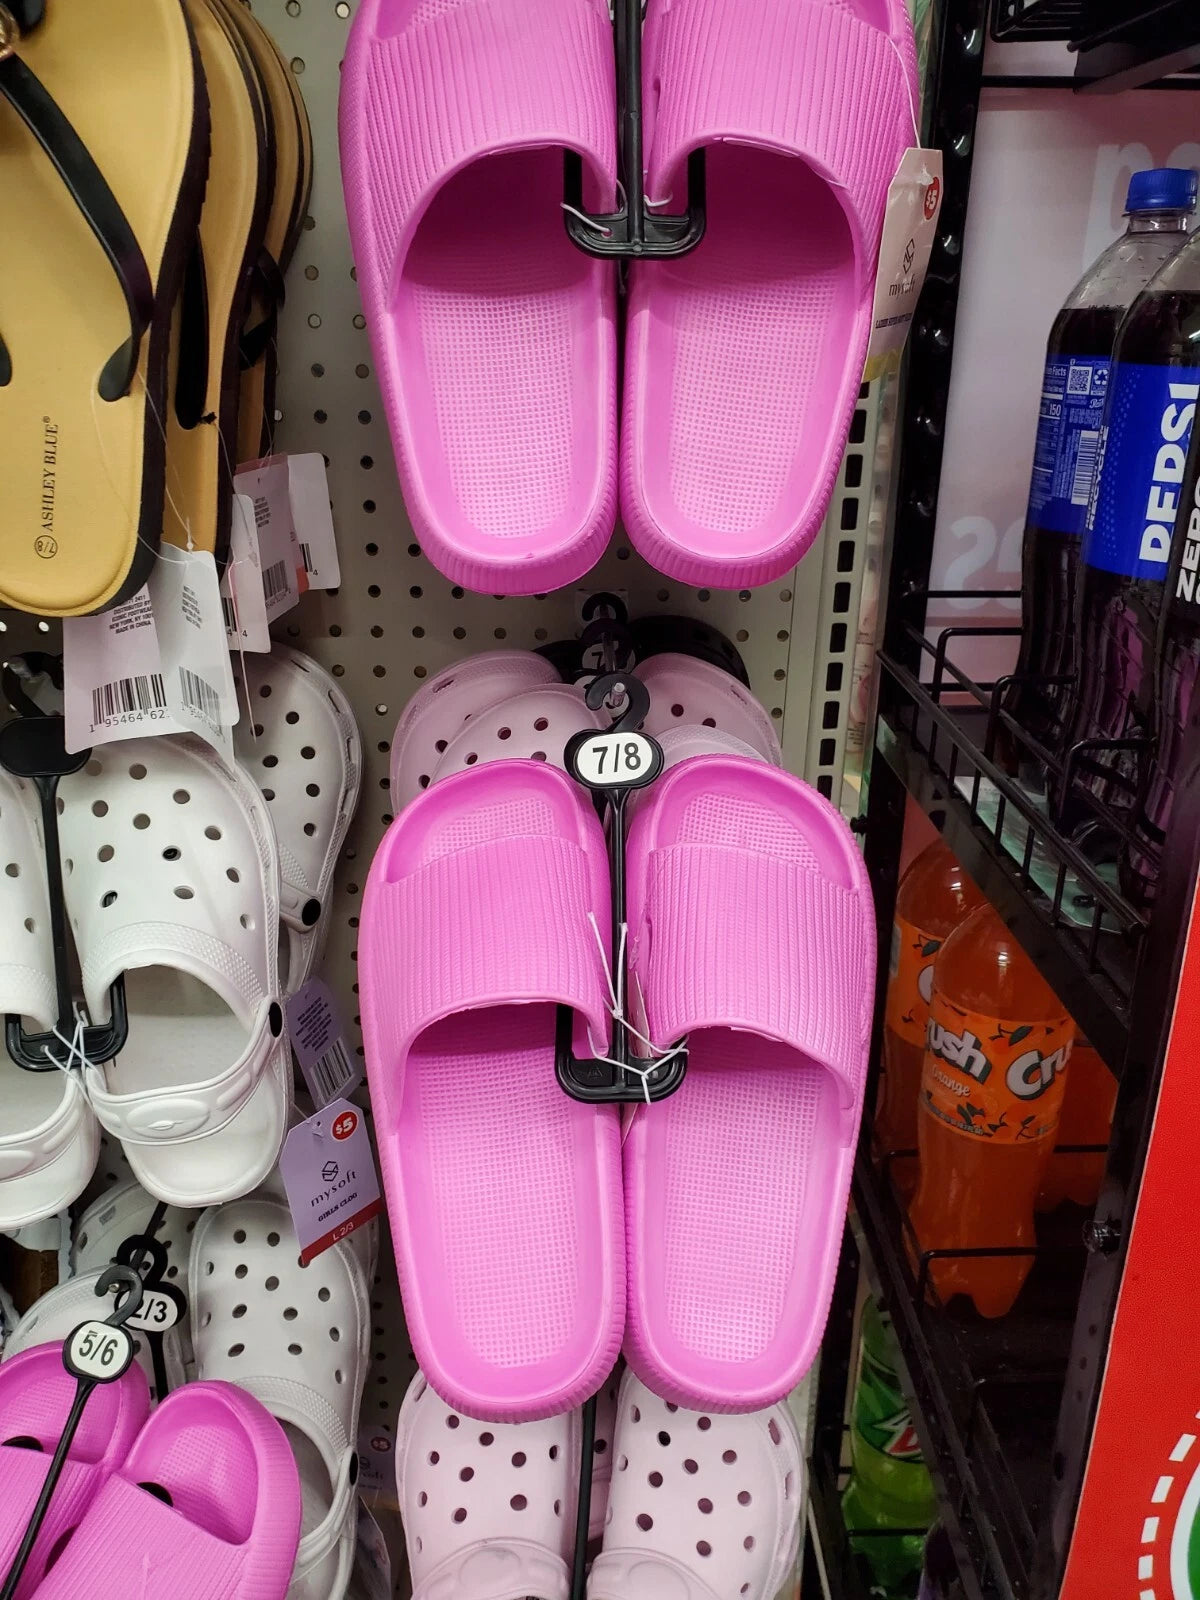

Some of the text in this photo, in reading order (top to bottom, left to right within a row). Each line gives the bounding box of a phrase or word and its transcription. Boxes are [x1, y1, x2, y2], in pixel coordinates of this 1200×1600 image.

[1049, 404, 1062, 416] 150
[41, 469, 56, 532] ASHLEY
[135, 620, 151, 628] CHINA
[104, 712, 144, 728] 95464
[150, 709, 170, 720] 62
[592, 742, 642, 775] 7/8
[335, 1116, 354, 1134] $5
[310, 1168, 357, 1208] mysoft
[317, 1192, 358, 1223] GIRLS CLOG
[78, 1329, 118, 1367] 5/6
